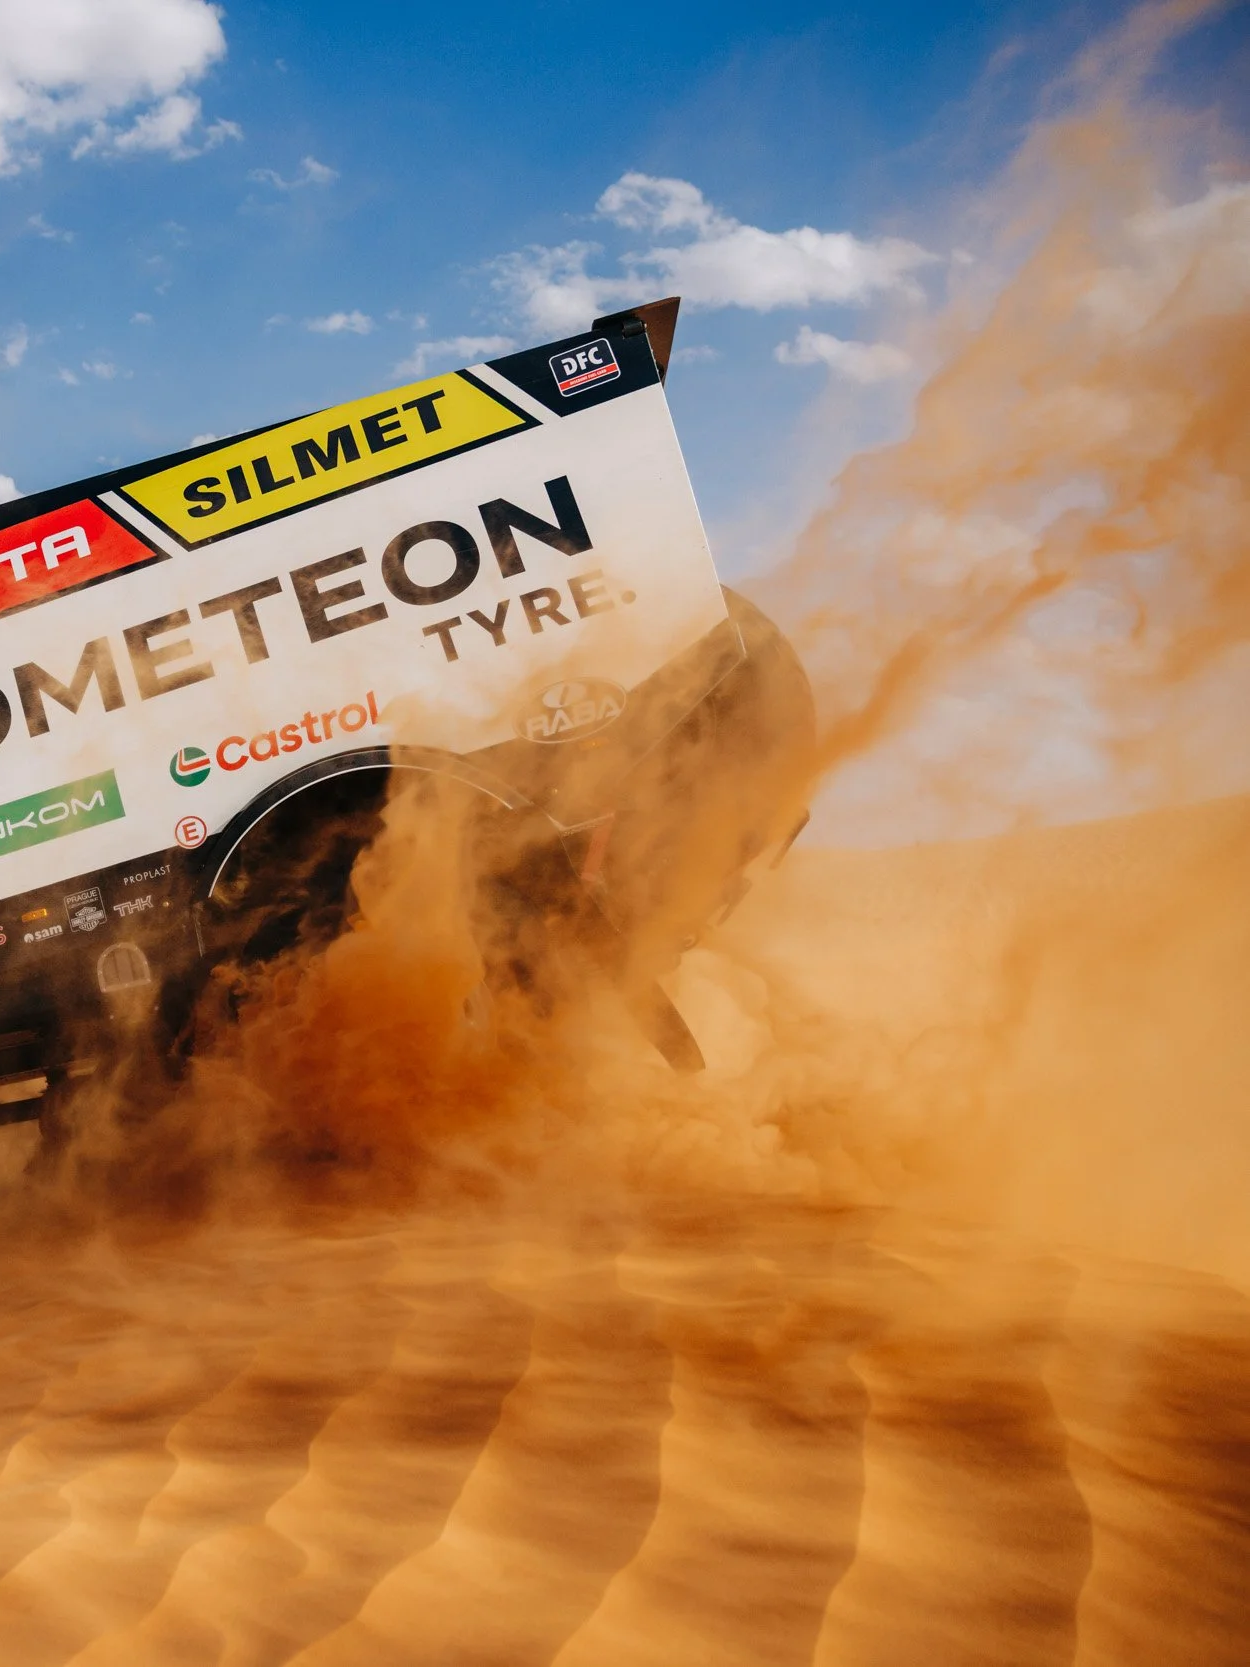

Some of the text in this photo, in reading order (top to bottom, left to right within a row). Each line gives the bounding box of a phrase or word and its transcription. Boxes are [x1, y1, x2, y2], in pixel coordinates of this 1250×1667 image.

[561, 346, 603, 376] DFC
[182, 388, 447, 520] SILMET
[216, 690, 381, 772] Castrol
[123, 864, 171, 886] PROPLAST
[66, 889, 98, 905] PRAGUE
[113, 895, 154, 917] THK
[34, 923, 64, 941] sam
